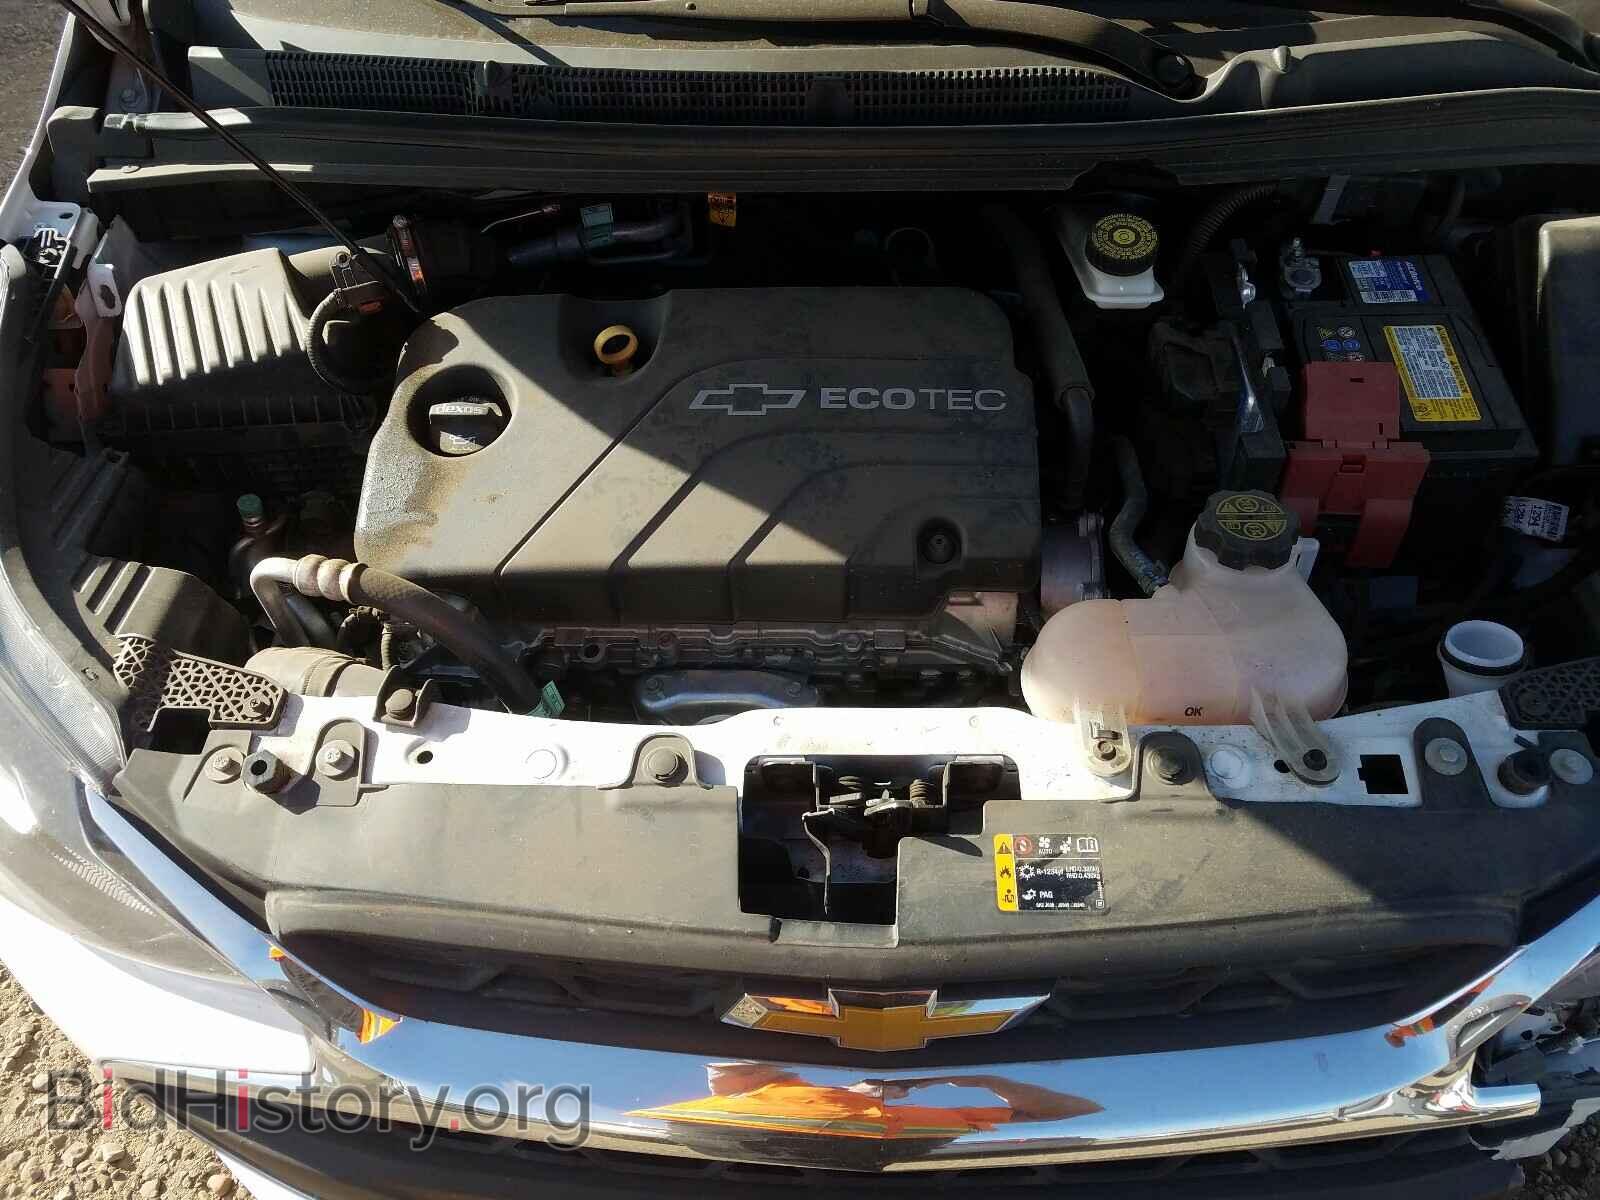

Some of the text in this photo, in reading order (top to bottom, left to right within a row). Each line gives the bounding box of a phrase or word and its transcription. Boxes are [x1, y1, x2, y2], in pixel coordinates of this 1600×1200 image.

[820, 387, 1006, 411] ECOTEC
[436, 403, 482, 414] dexos
[1184, 706, 1203, 717] OK
[1039, 890, 1054, 899] PAG
